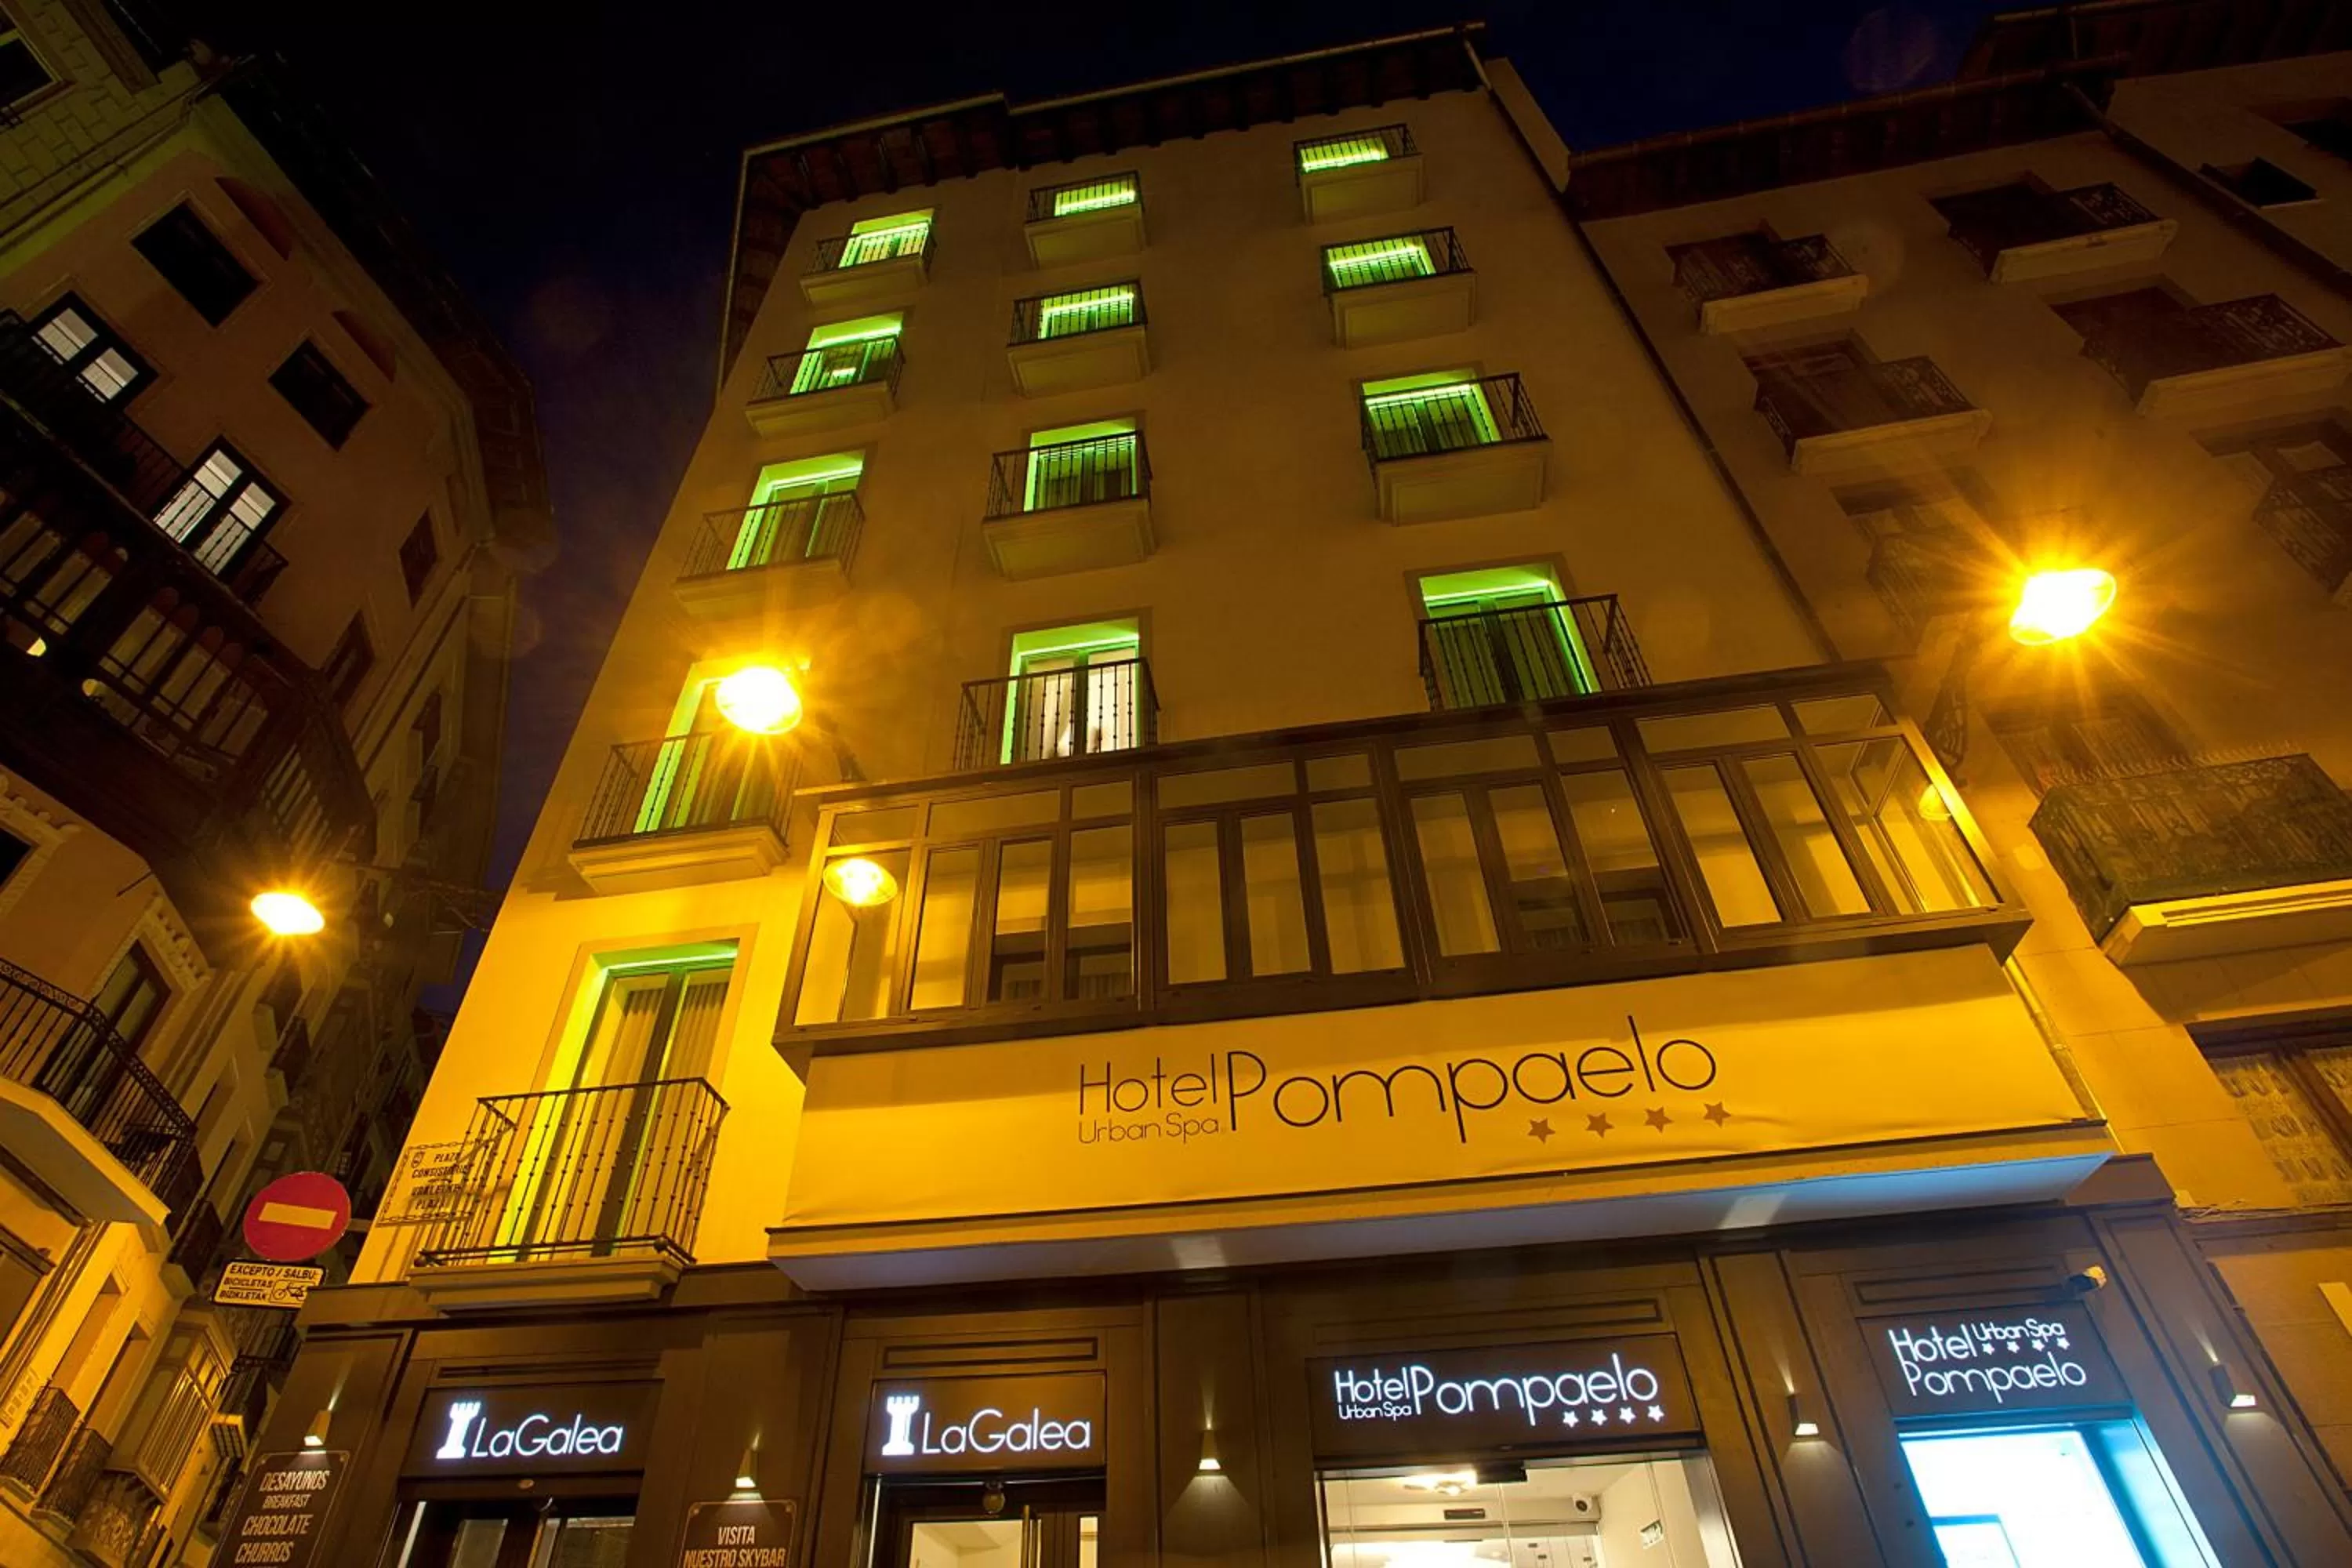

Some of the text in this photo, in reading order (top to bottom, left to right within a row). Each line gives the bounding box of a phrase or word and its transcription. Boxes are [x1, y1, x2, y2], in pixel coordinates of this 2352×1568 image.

[1078, 1015, 1718, 1145] Hotel Pompaelo
[1078, 1111, 1219, 1145] Urban Spa
[229, 1264, 276, 1277] EXCEPTO
[1888, 1318, 2066, 1363] Hotel Urban Spa
[1902, 1350, 2086, 1404] Pompaelo
[1334, 1352, 1658, 1426] Hotel Pompaelo
[1338, 1400, 1412, 1421] Urban Spa
[258, 1469, 331, 1492] DESAYUNOS
[262, 1493, 312, 1509] BREAKFAST
[241, 1513, 314, 1536] CHOCOLATE
[717, 1525, 756, 1545] VISITA
[234, 1540, 296, 1564] CHURROS
[683, 1546, 786, 1568] NUESTRO SKYBAR
